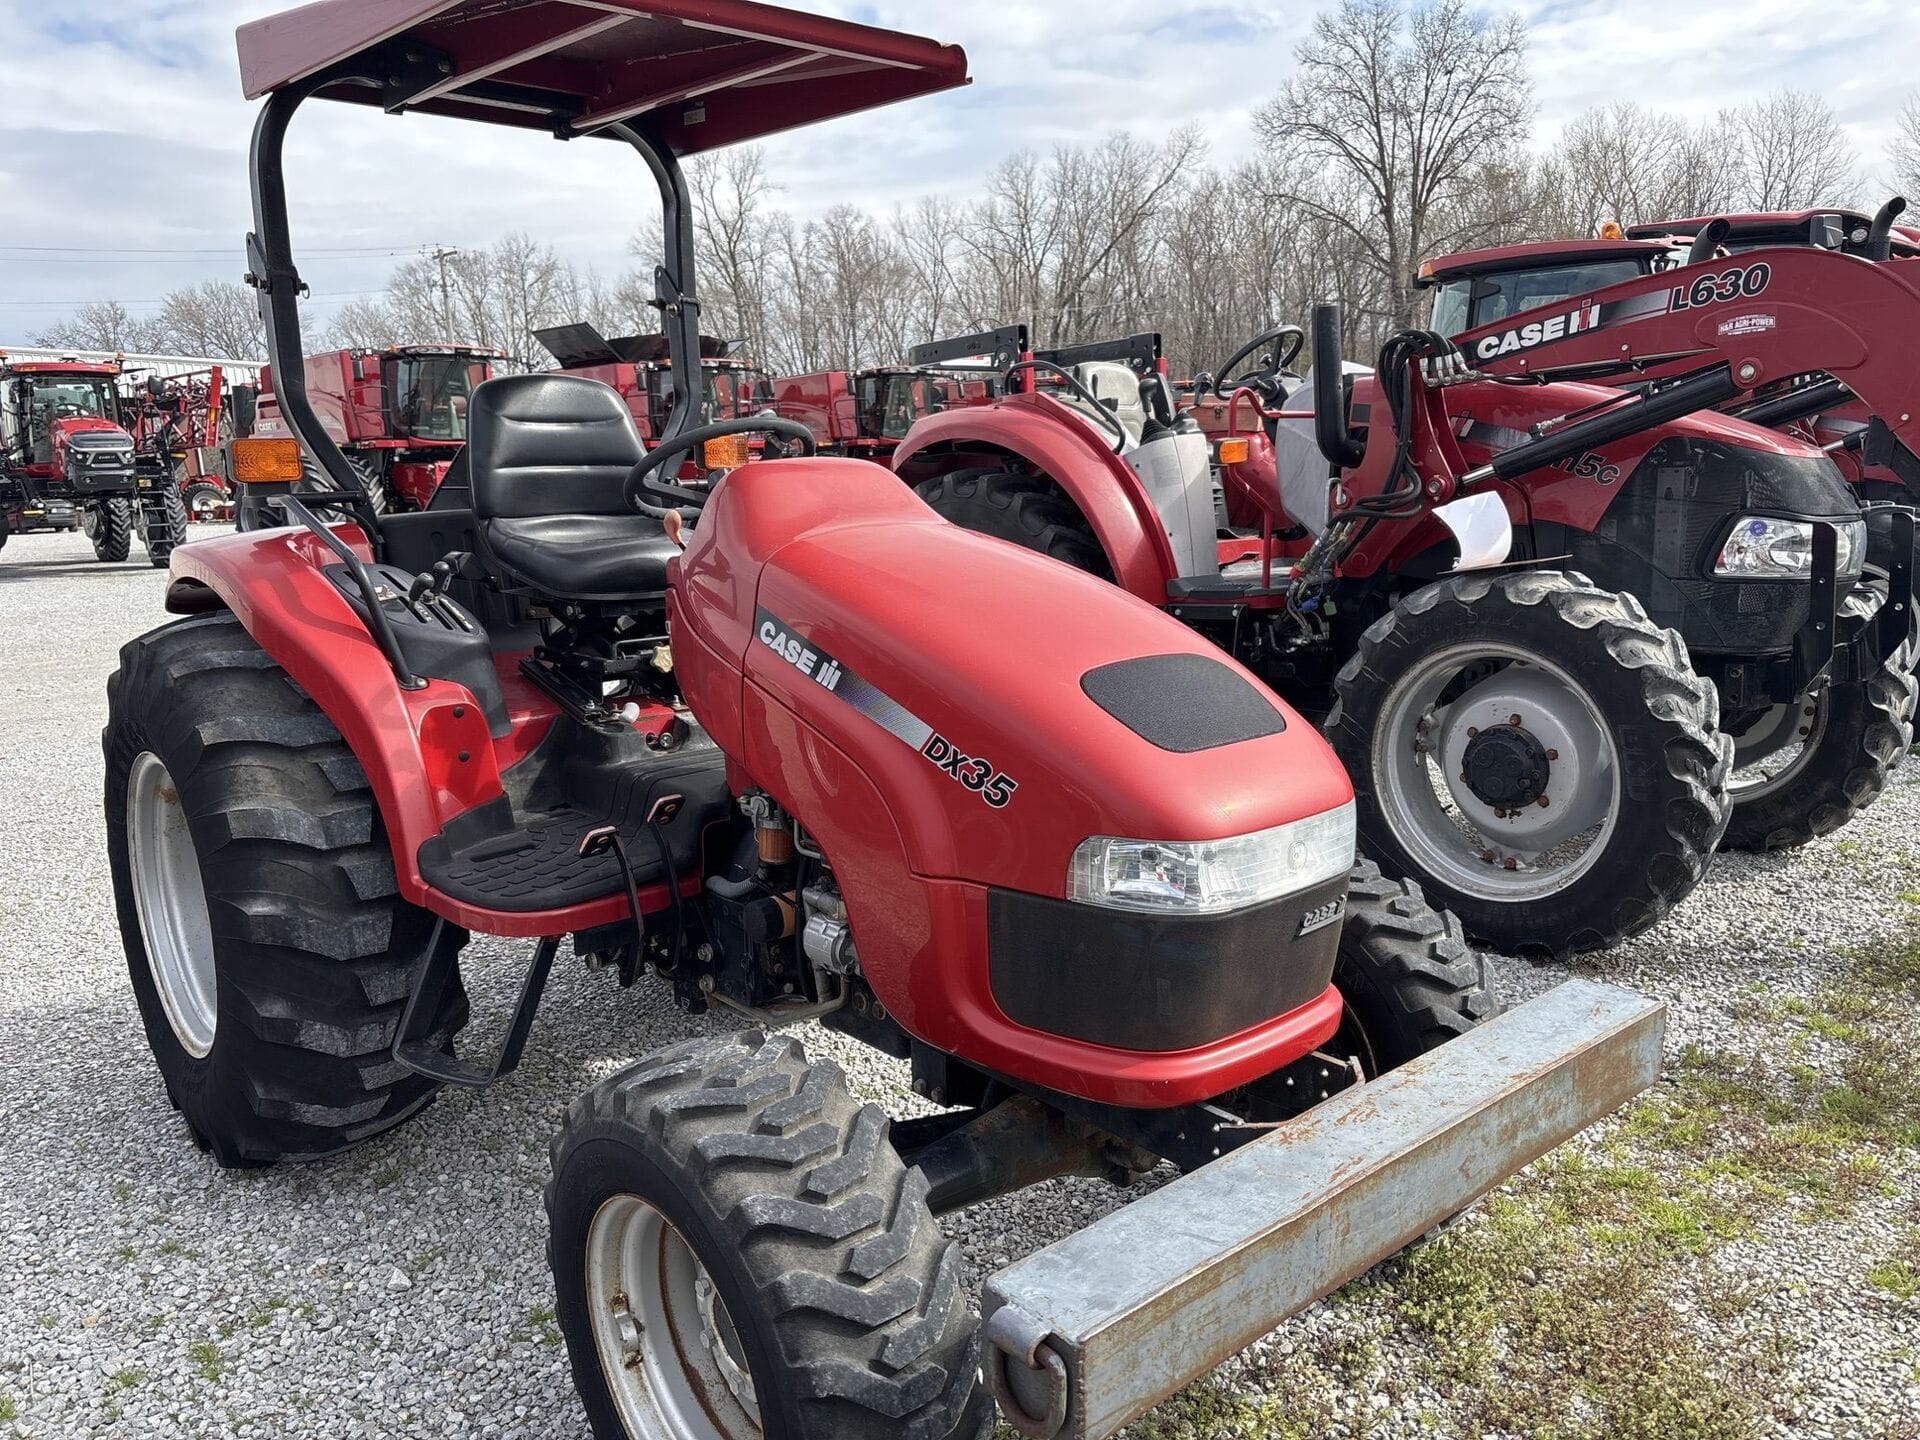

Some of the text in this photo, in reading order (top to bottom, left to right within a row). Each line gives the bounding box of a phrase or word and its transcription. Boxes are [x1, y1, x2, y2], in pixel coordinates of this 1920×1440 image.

[1669, 262, 1771, 313] L630
[1476, 298, 1601, 360] CASE IH
[759, 621, 818, 675] CASE
[922, 733, 1019, 808] DX35
[1303, 901, 1337, 927] CASE
